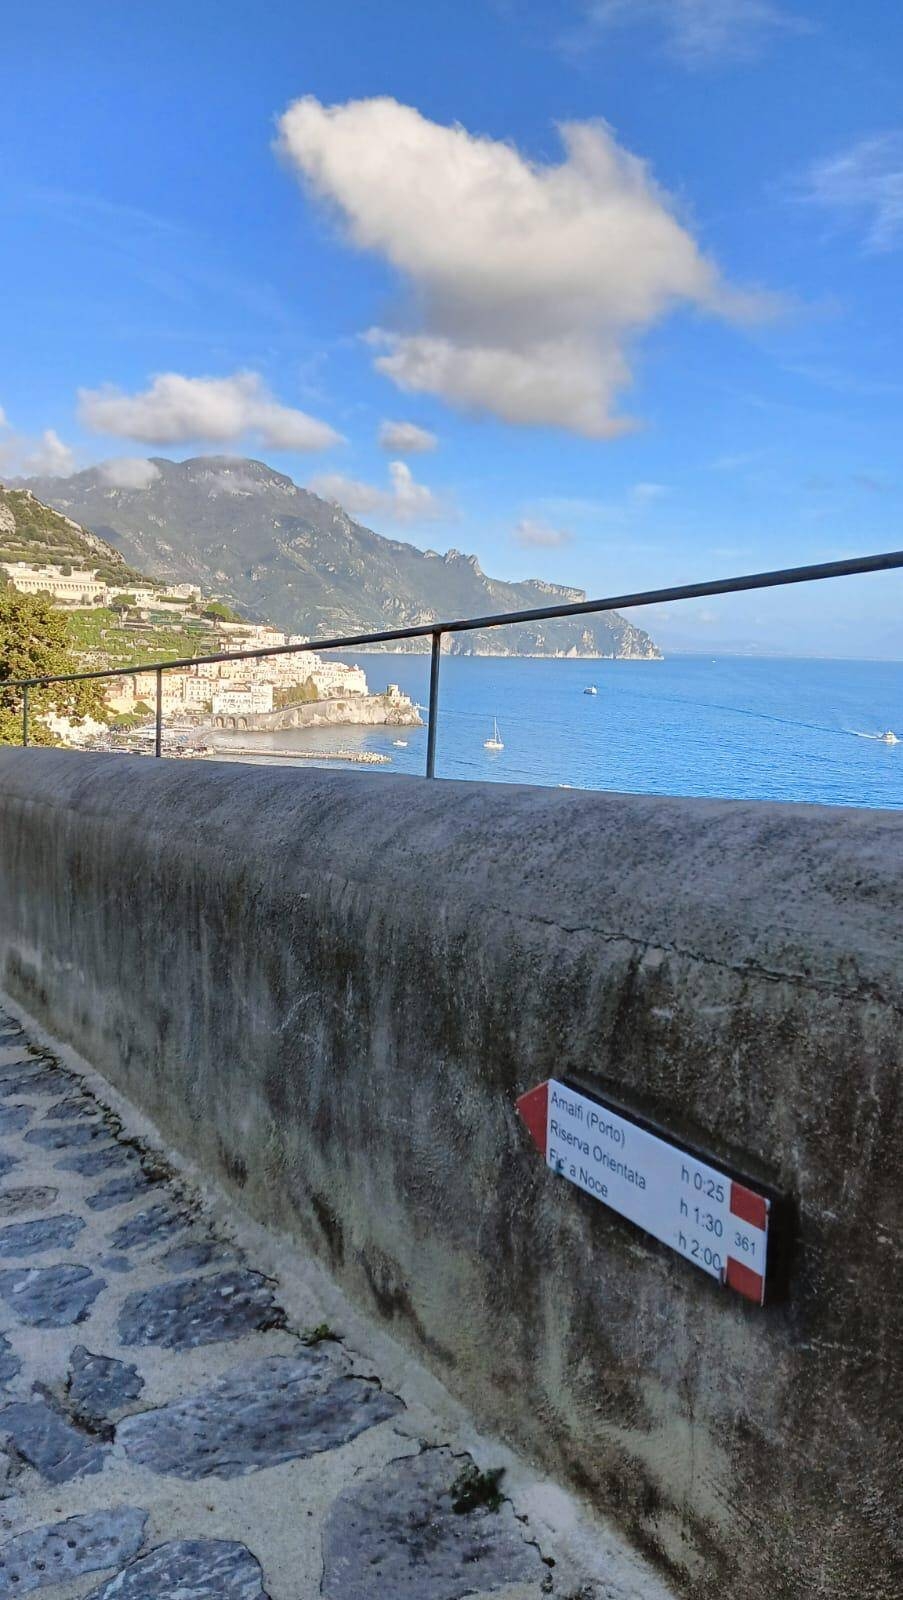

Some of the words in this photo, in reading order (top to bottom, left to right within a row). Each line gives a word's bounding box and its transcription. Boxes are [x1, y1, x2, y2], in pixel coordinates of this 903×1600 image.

[551, 1091, 583, 1120] Amalfi
[587, 1111, 625, 1149] (Porto)
[550, 1120, 590, 1155] Riserva
[593, 1146, 646, 1189] Orientata
[580, 1168, 608, 1197] Noce
[681, 1165, 689, 1181] h
[694, 1173, 724, 1203] 0:25
[680, 1198, 688, 1216] h
[695, 1208, 723, 1237] 1:30
[679, 1231, 687, 1249] h
[691, 1240, 721, 1271] 2:00
[734, 1232, 756, 1256] 361
